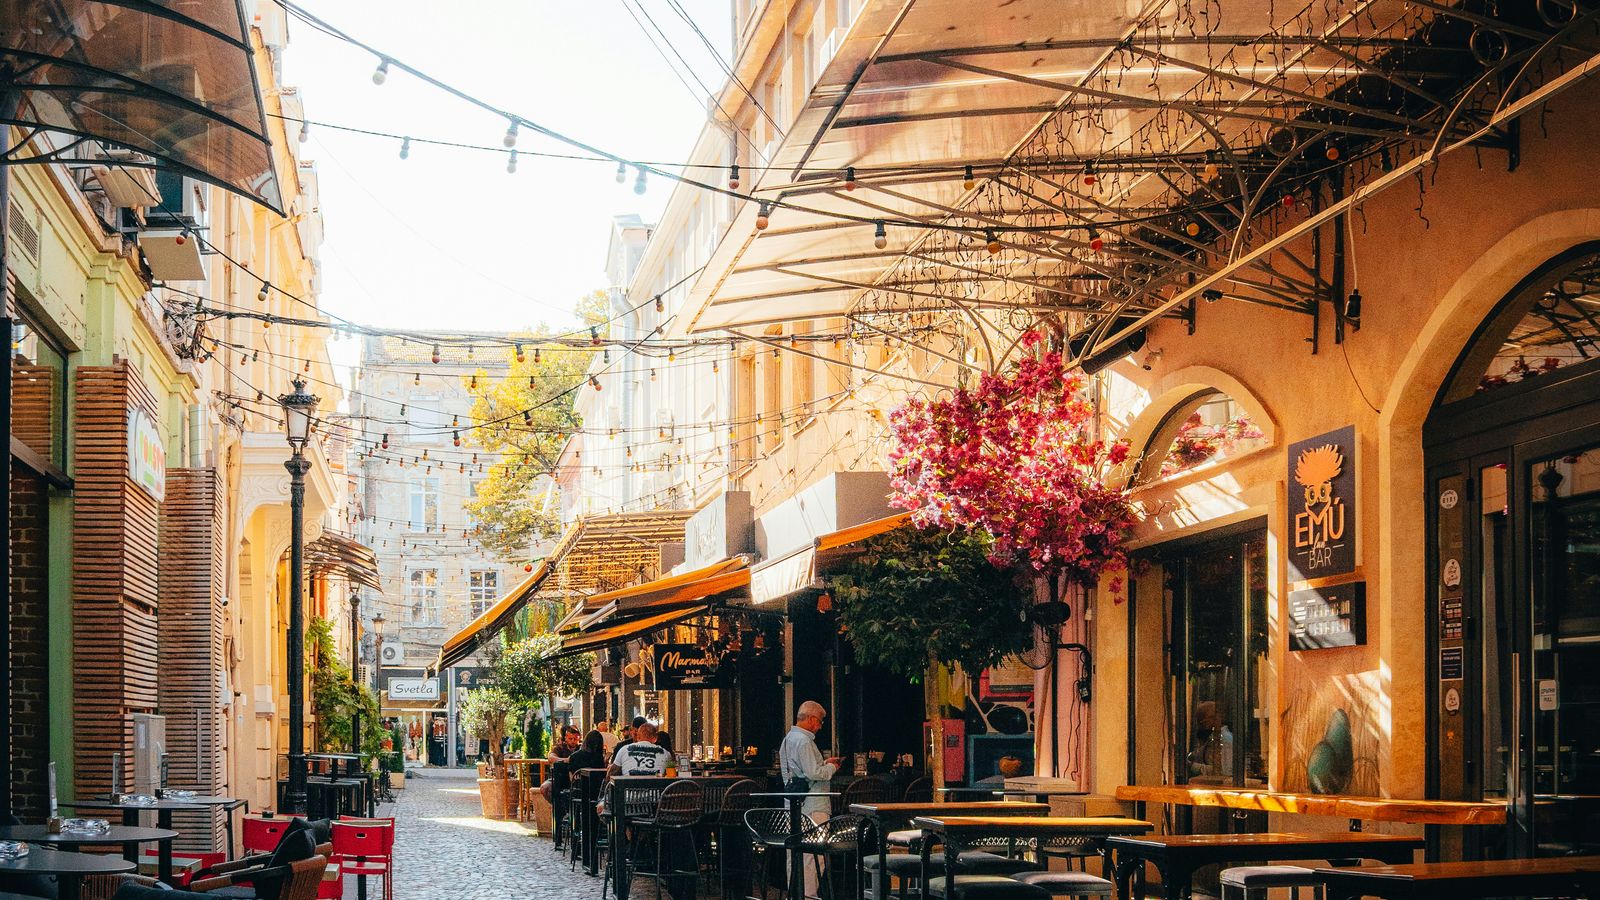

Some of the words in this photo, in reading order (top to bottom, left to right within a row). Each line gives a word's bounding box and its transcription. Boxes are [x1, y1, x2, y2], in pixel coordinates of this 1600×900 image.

[1309, 547, 1332, 570] BAR
[660, 651, 720, 672] Marma
[395, 683, 433, 694] Svetla
[633, 756, 656, 769] Y-3
